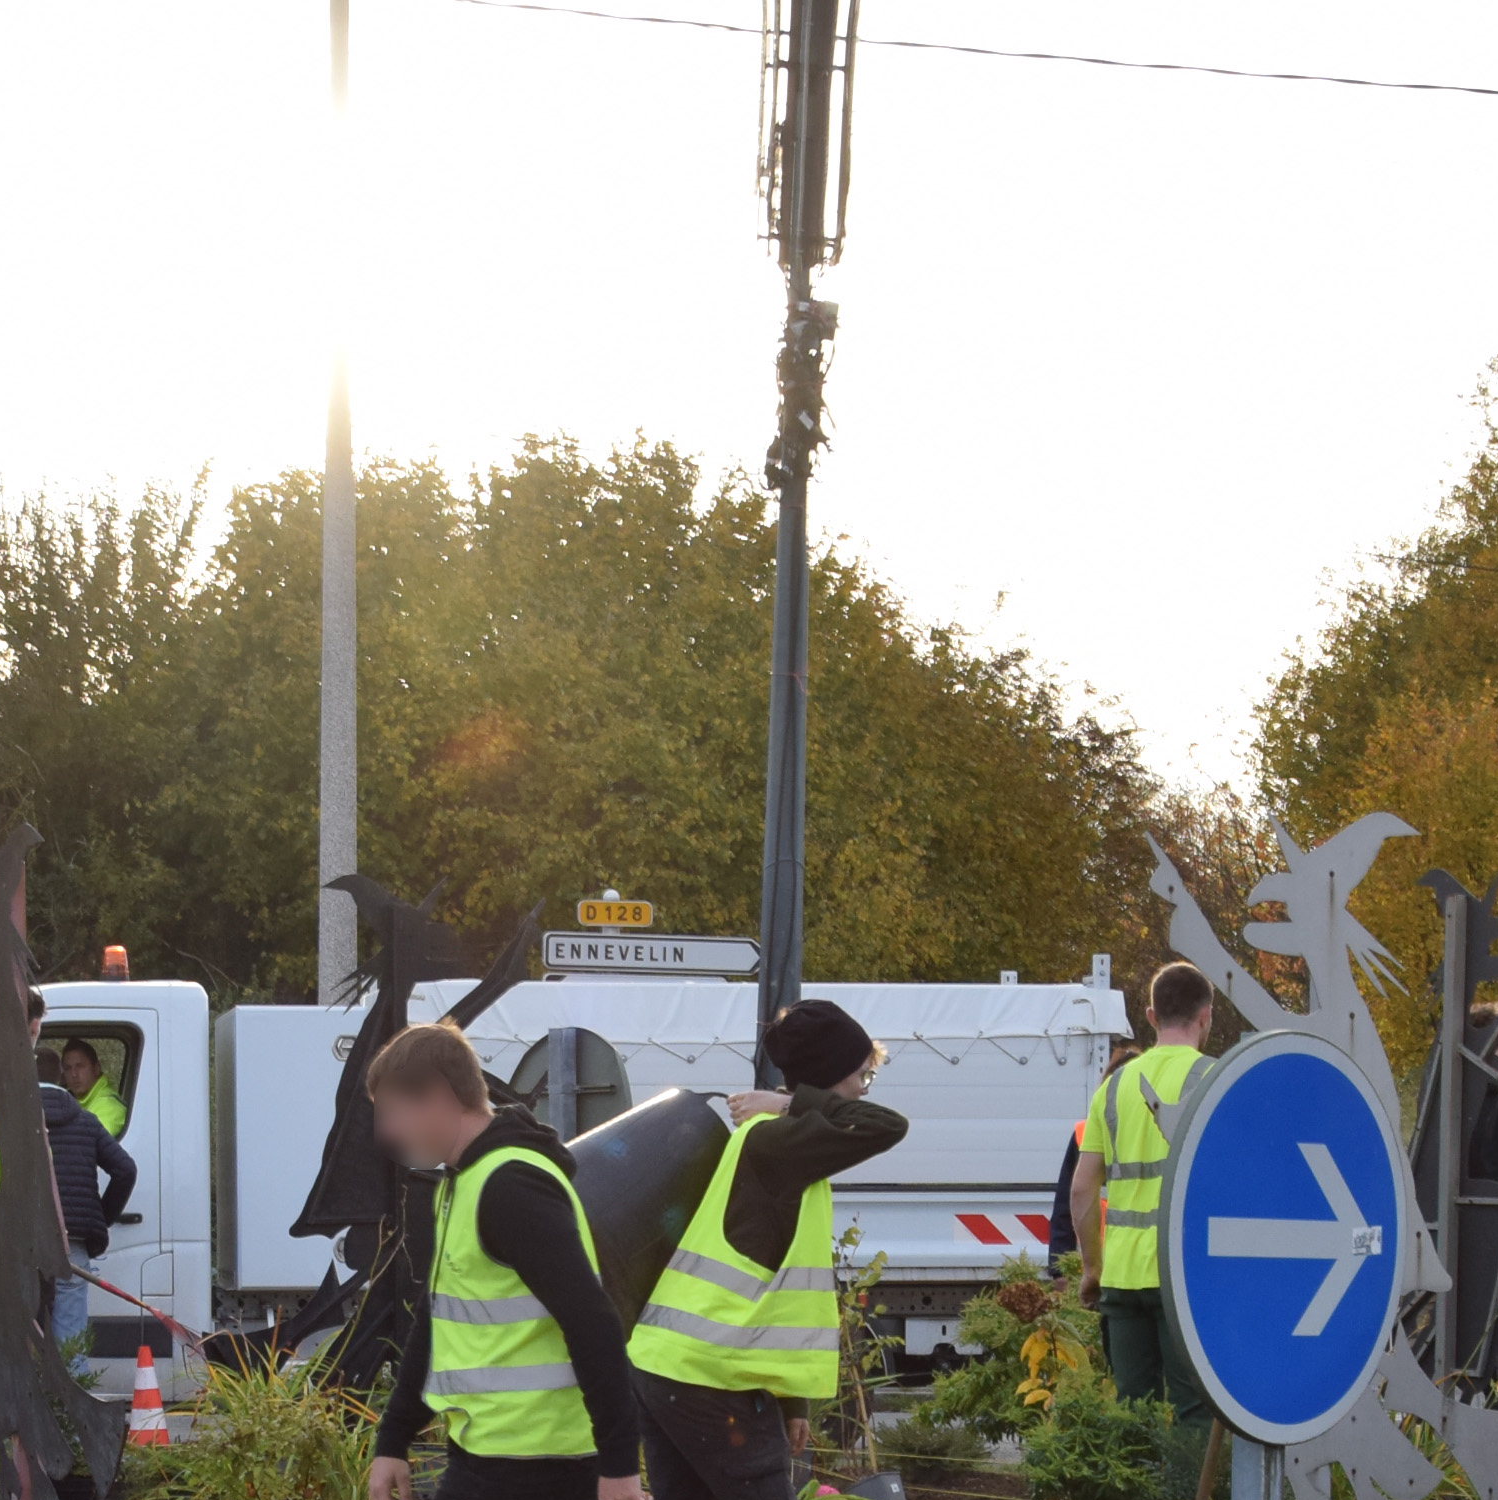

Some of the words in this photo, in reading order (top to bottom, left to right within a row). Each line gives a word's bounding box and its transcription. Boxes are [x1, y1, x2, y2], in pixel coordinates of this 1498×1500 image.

[586, 905, 597, 920] D
[605, 905, 642, 922] 128
[555, 943, 684, 963] ENNEVELIN
